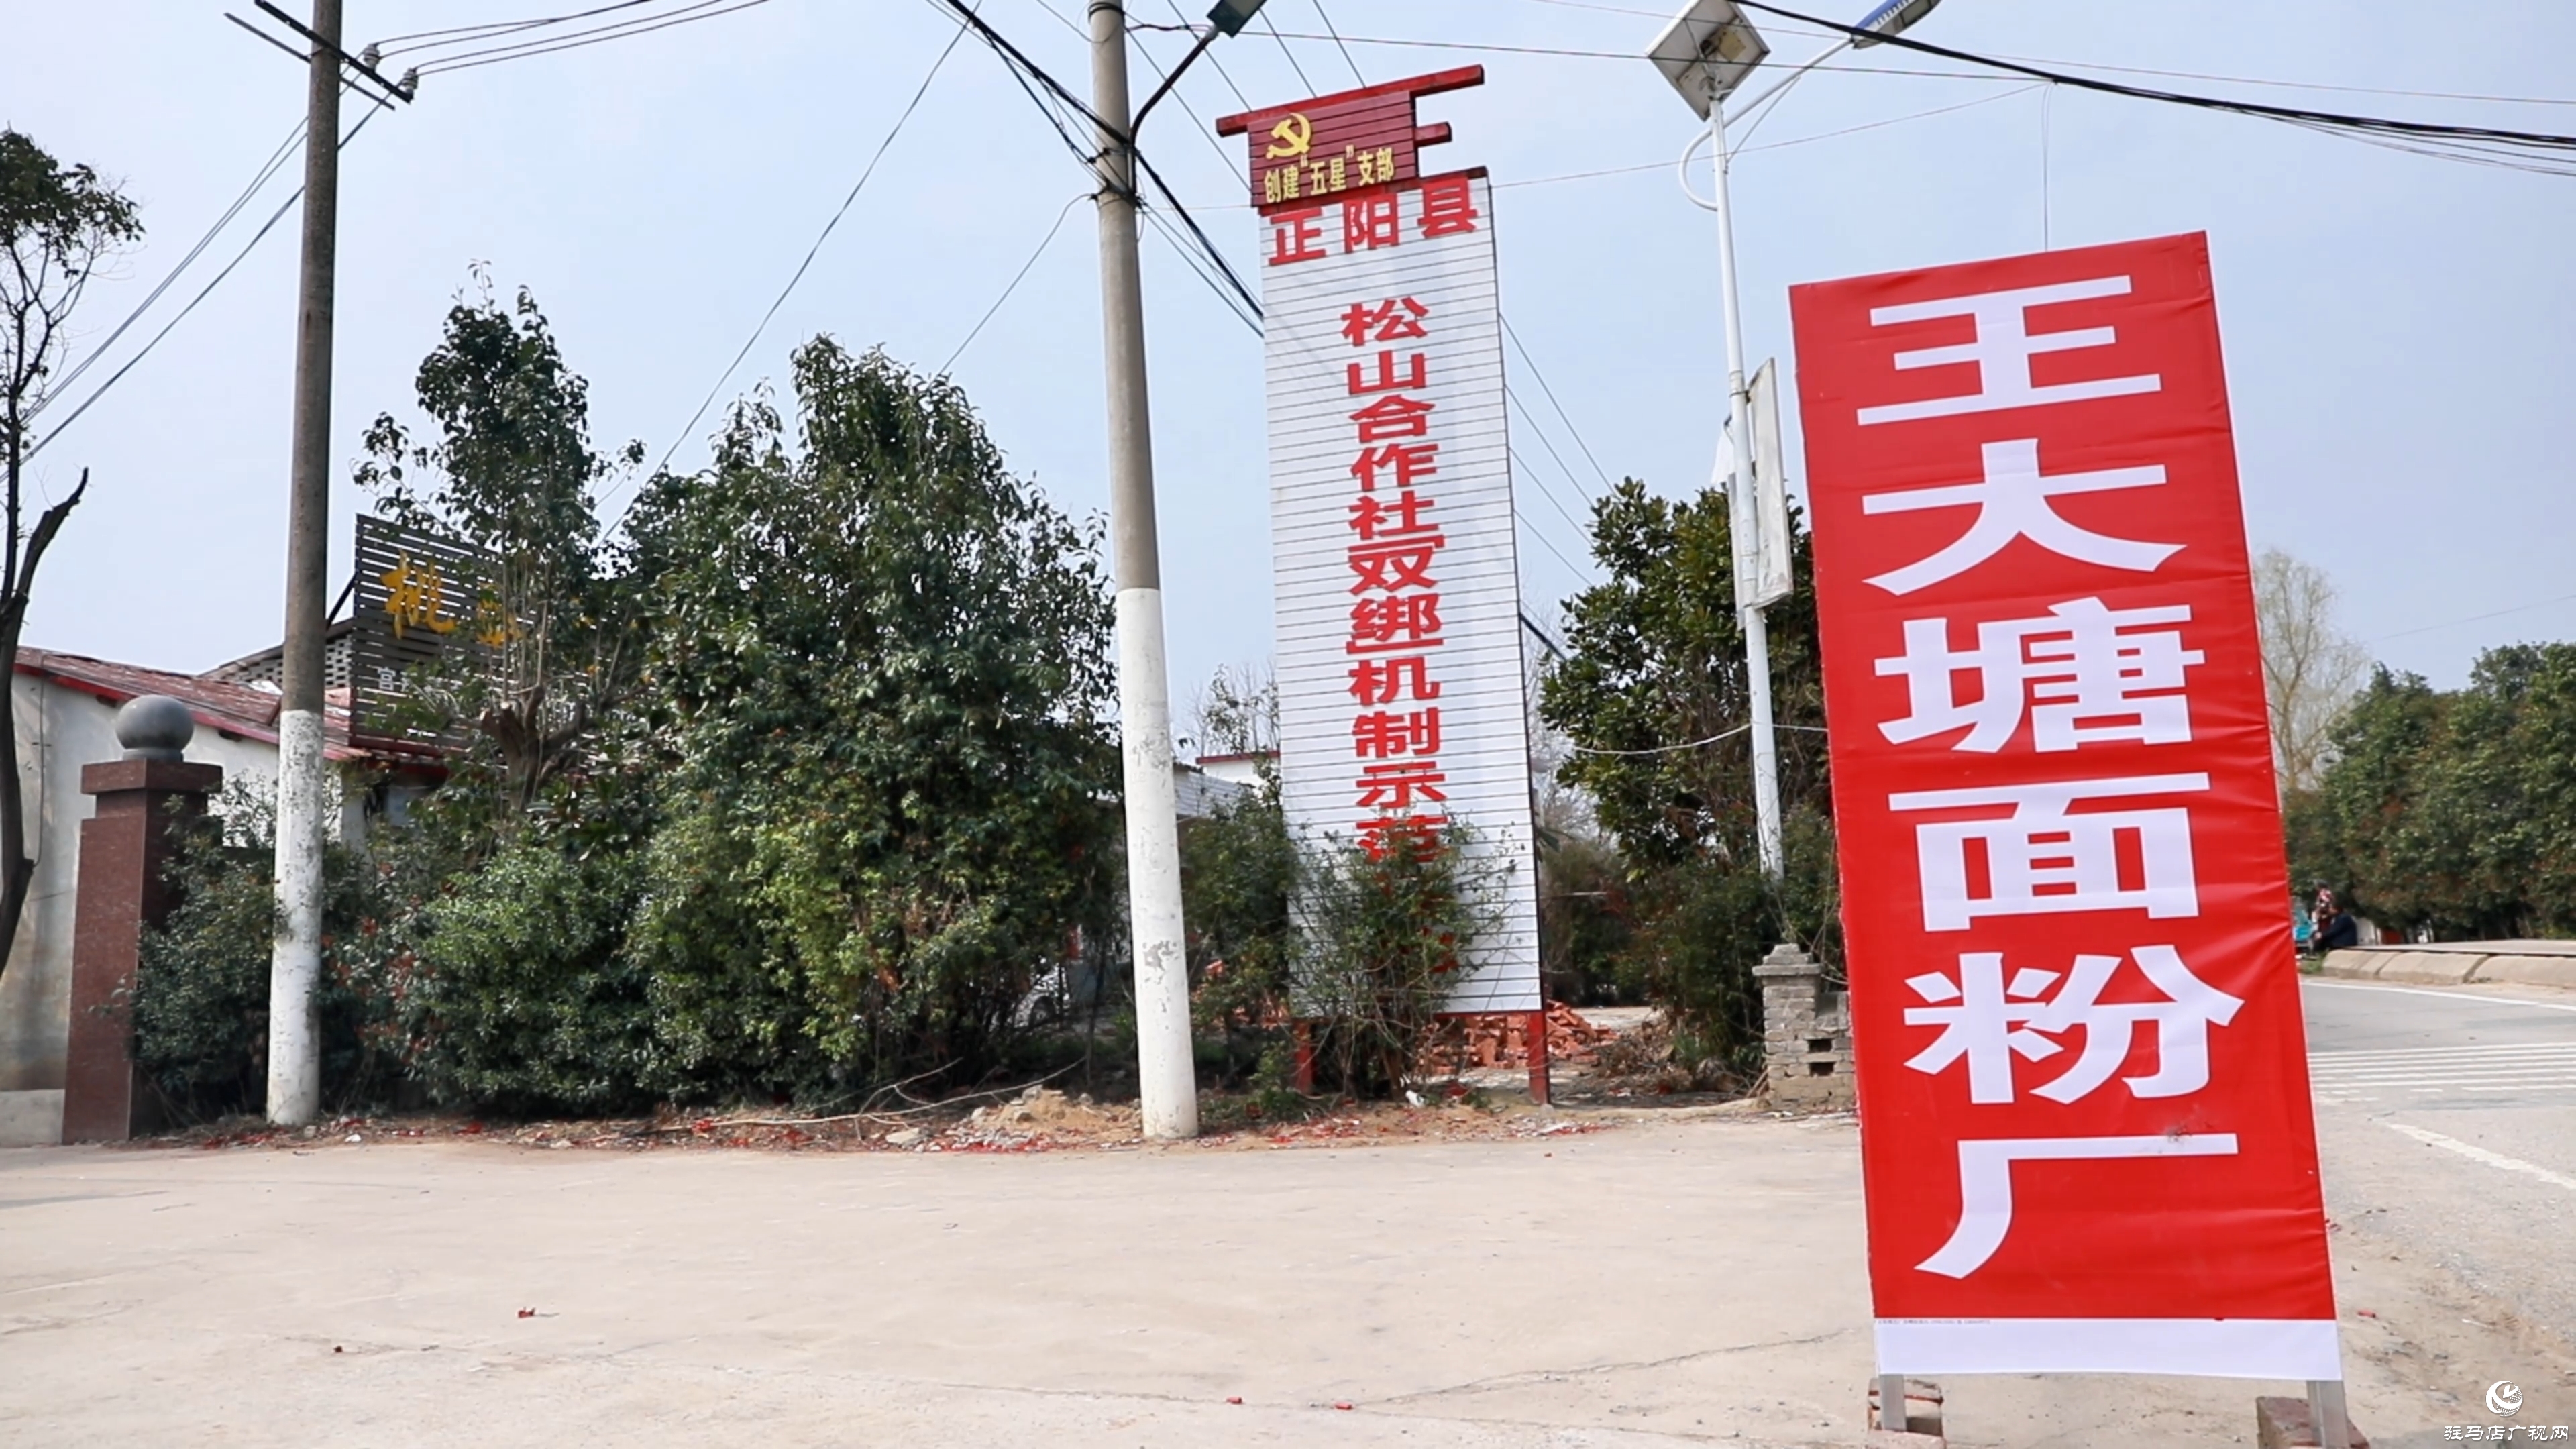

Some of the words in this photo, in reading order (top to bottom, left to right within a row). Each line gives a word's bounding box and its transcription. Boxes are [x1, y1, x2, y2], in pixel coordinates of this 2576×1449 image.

[1269, 176, 1477, 266] 正阳县
[1857, 275, 2244, 1279] 王大塘面粉厂
